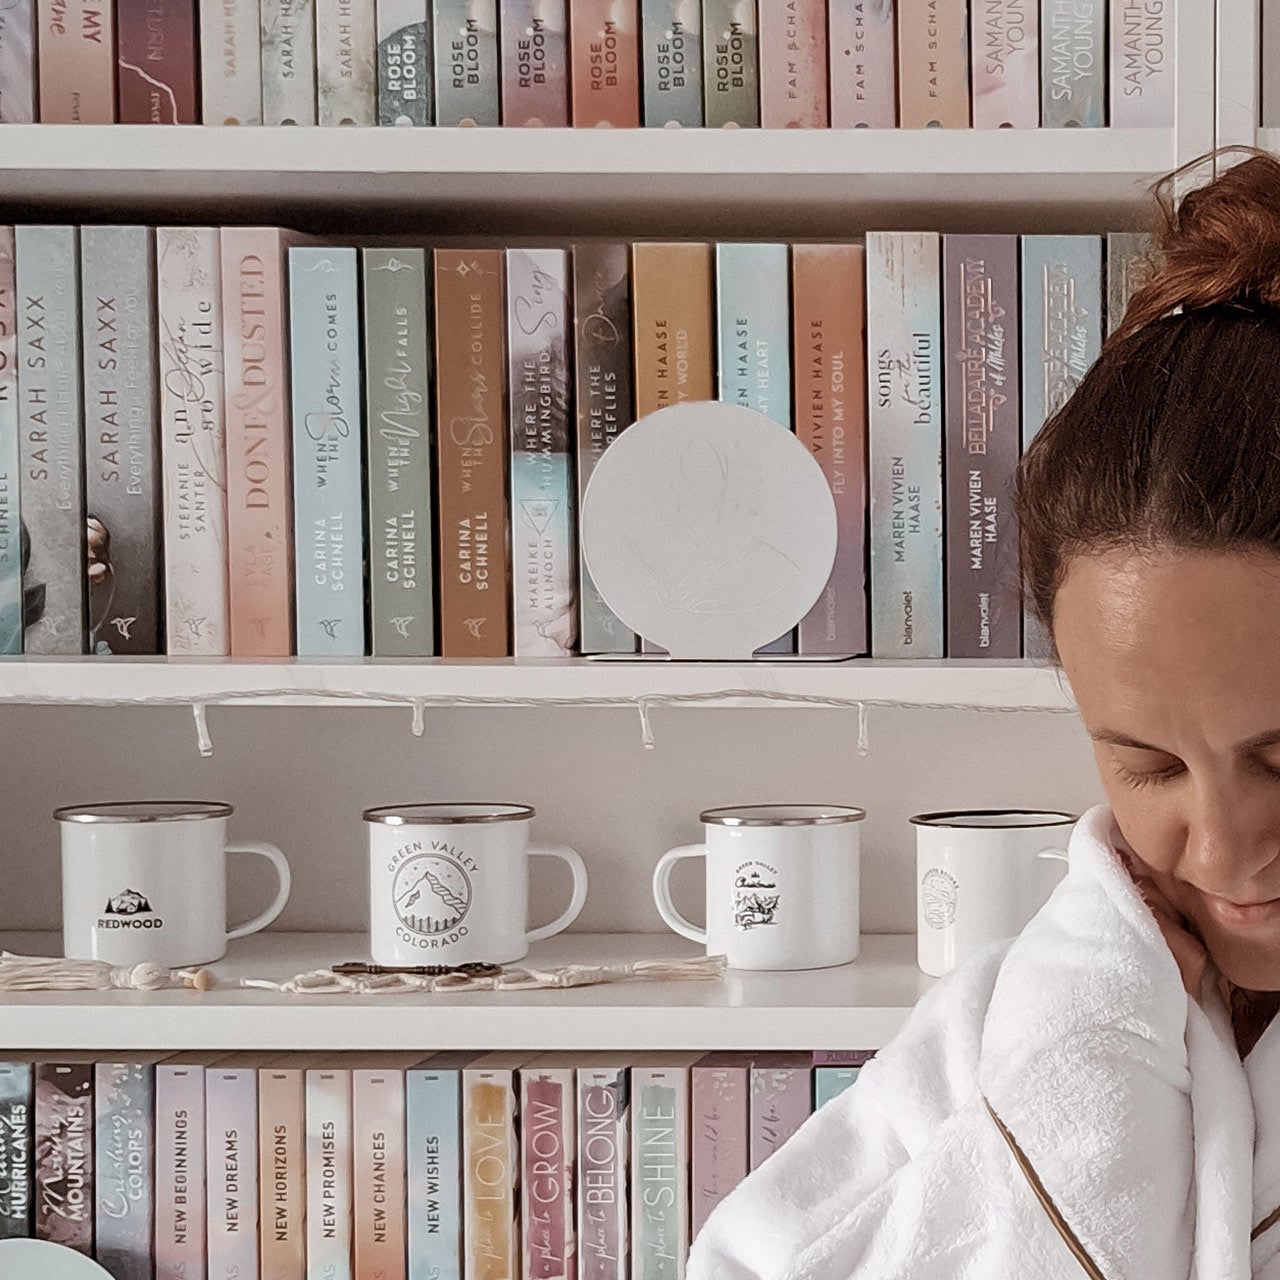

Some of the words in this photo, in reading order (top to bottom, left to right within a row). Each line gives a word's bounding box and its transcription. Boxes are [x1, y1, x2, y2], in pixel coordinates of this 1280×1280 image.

[387, 43, 401, 91] ROSE
[403, 34, 418, 100] BLOOM
[451, 40, 465, 89] ROSE
[466, 18, 480, 85] BLOOM
[518, 40, 532, 88] ROSE
[533, 18, 546, 84] BLOOM
[590, 43, 604, 91] ROSE
[604, 21, 618, 87] BLOOM
[716, 44, 730, 92] ROSE
[730, 22, 744, 88] BLOOM
[1144, 1, 1164, 77] YOUNG
[26, 294, 45, 369] SAXX
[810, 319, 824, 379] HAASE
[524, 360, 536, 394] THE
[875, 349, 894, 408] songs
[913, 332, 933, 425] beautiful
[29, 387, 48, 482] SARAH
[525, 401, 538, 466] WHERE
[177, 463, 191, 541] STEFANIE
[193, 469, 206, 532] SANTER
[969, 470, 982, 517] VIVIEN
[984, 497, 997, 542] HAASE
[386, 516, 399, 582] CARINA
[402, 510, 415, 588] SCHNELL
[969, 518, 982, 569] MAREN
[388, 841, 423, 873] GREEN
[431, 841, 479, 873] VALLEY
[97, 919, 163, 929] REDWOOD
[395, 926, 469, 949] COLORADO
[11, 1104, 27, 1219] HURRICANES
[66, 1106, 84, 1221] MOUNTAINS
[129, 1129, 143, 1200] COLORS
[174, 1110, 188, 1205] BEGINNINGS
[226, 1129, 238, 1193] DREAMS
[275, 1125, 287, 1202] HORIZONS
[322, 1121, 335, 1199] PROMISES
[373, 1132, 385, 1203] CHANCES
[426, 1136, 439, 1194] WISHES
[475, 1114, 505, 1201] LOVE
[532, 1101, 559, 1203] GROW
[586, 1088, 615, 1204] BELONG
[642, 1105, 675, 1208] SHINE
[175, 1210, 187, 1244] NEW
[227, 1196, 238, 1232] NEW
[276, 1206, 287, 1241] NEW
[323, 1203, 335, 1238] NEW
[374, 1208, 386, 1243] NEW
[427, 1197, 439, 1233] NEW
